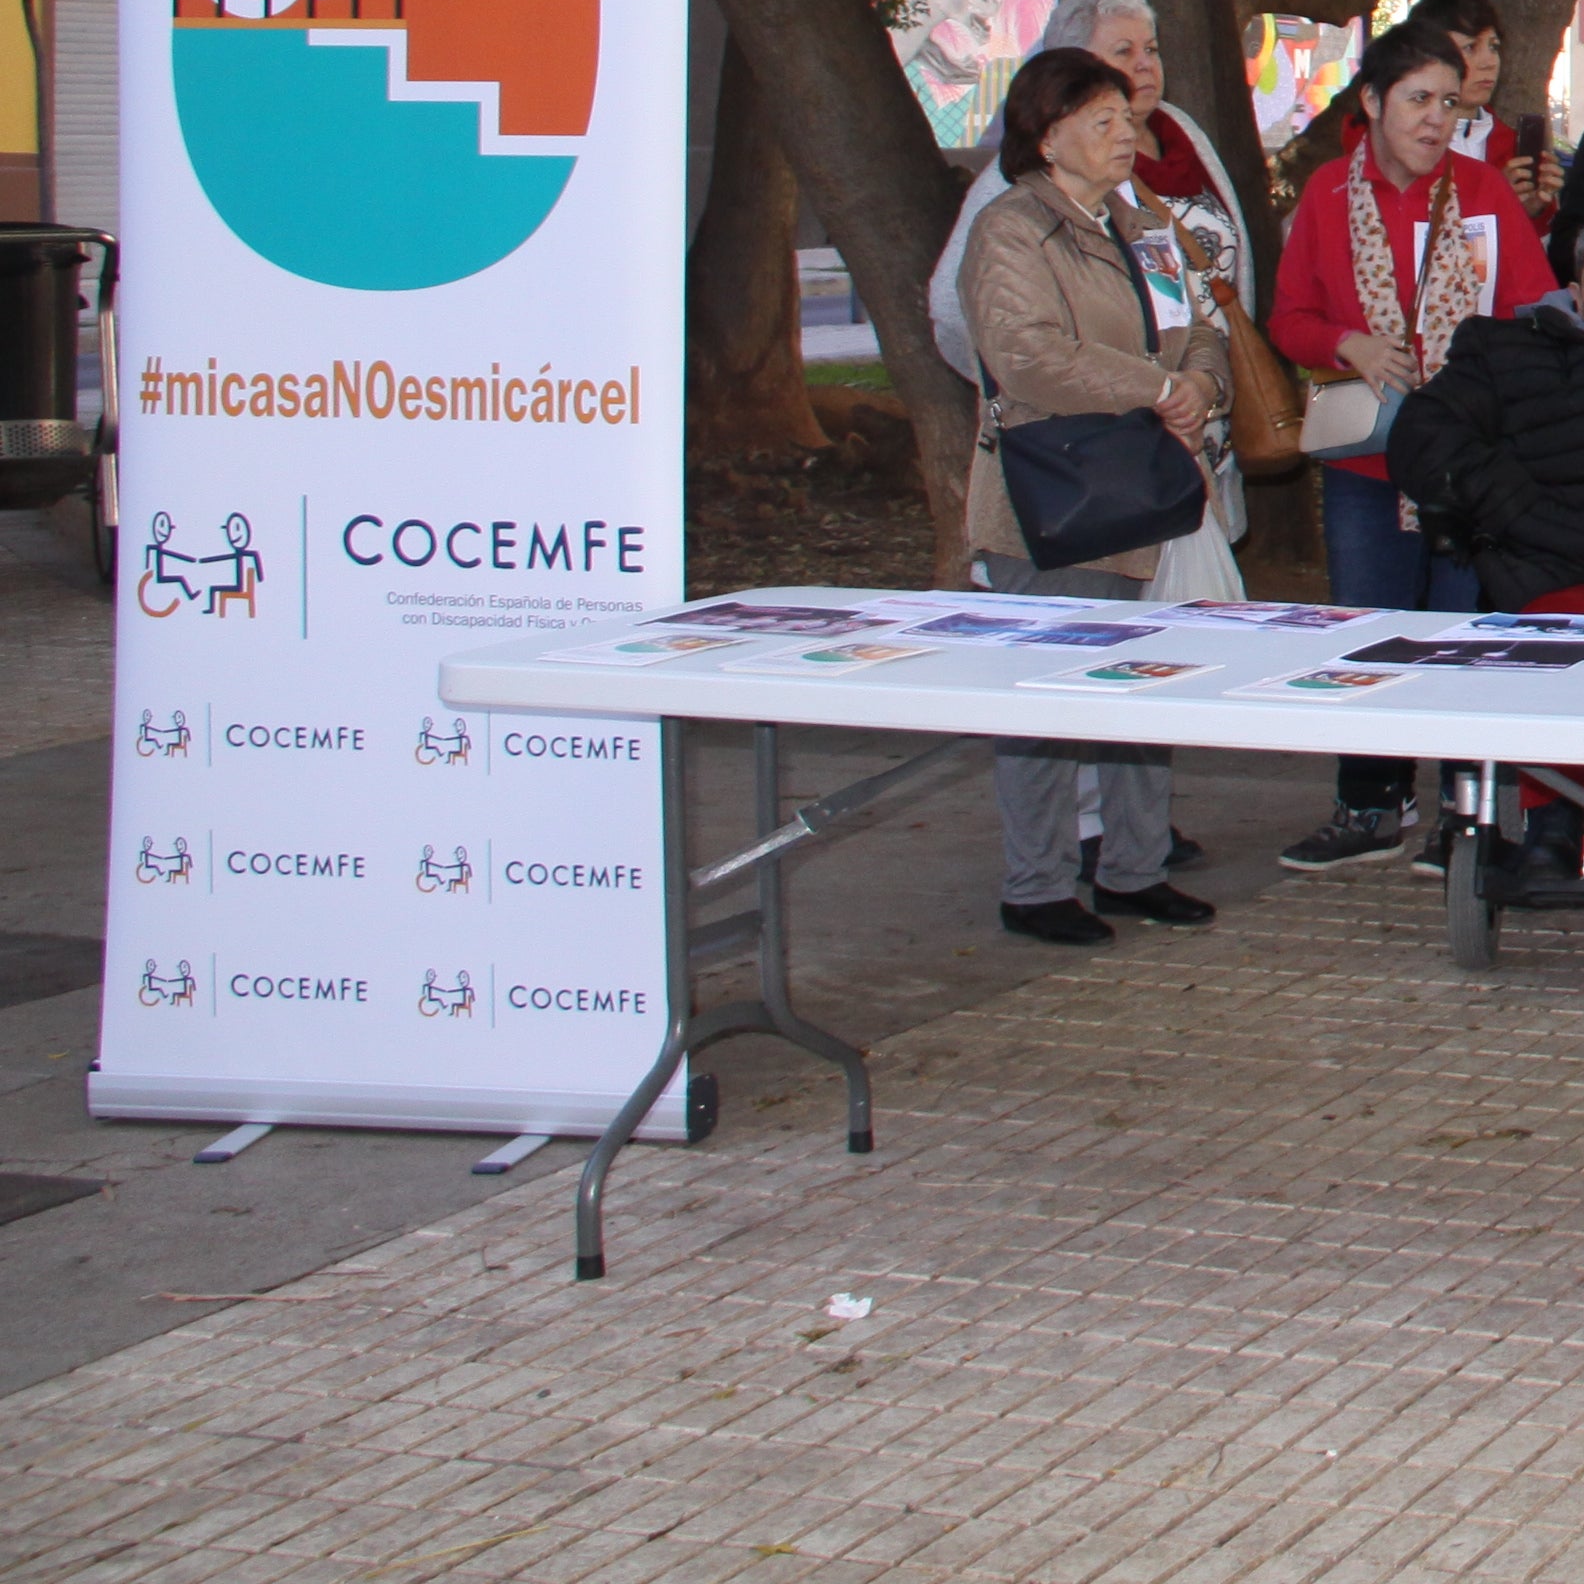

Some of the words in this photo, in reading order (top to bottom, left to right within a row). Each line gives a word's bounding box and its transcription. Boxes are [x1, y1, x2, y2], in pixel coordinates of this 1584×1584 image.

[139, 356, 640, 424] #micasaNOesmicárcel
[342, 514, 645, 573] COCEMFE
[387, 591, 485, 608] Confederación
[489, 595, 552, 612] Española
[556, 598, 573, 610] de
[577, 598, 643, 612] Personas
[402, 614, 428, 625] con
[432, 612, 523, 629] Discapacidad
[527, 615, 566, 629] Física
[225, 724, 365, 751] COCEMFE
[504, 732, 642, 760] COCEMFE
[227, 850, 366, 879] COCEMFE
[505, 861, 643, 889] COCEMFE
[230, 974, 369, 1003] COCEMFE
[508, 985, 647, 1014] COCEMFE
